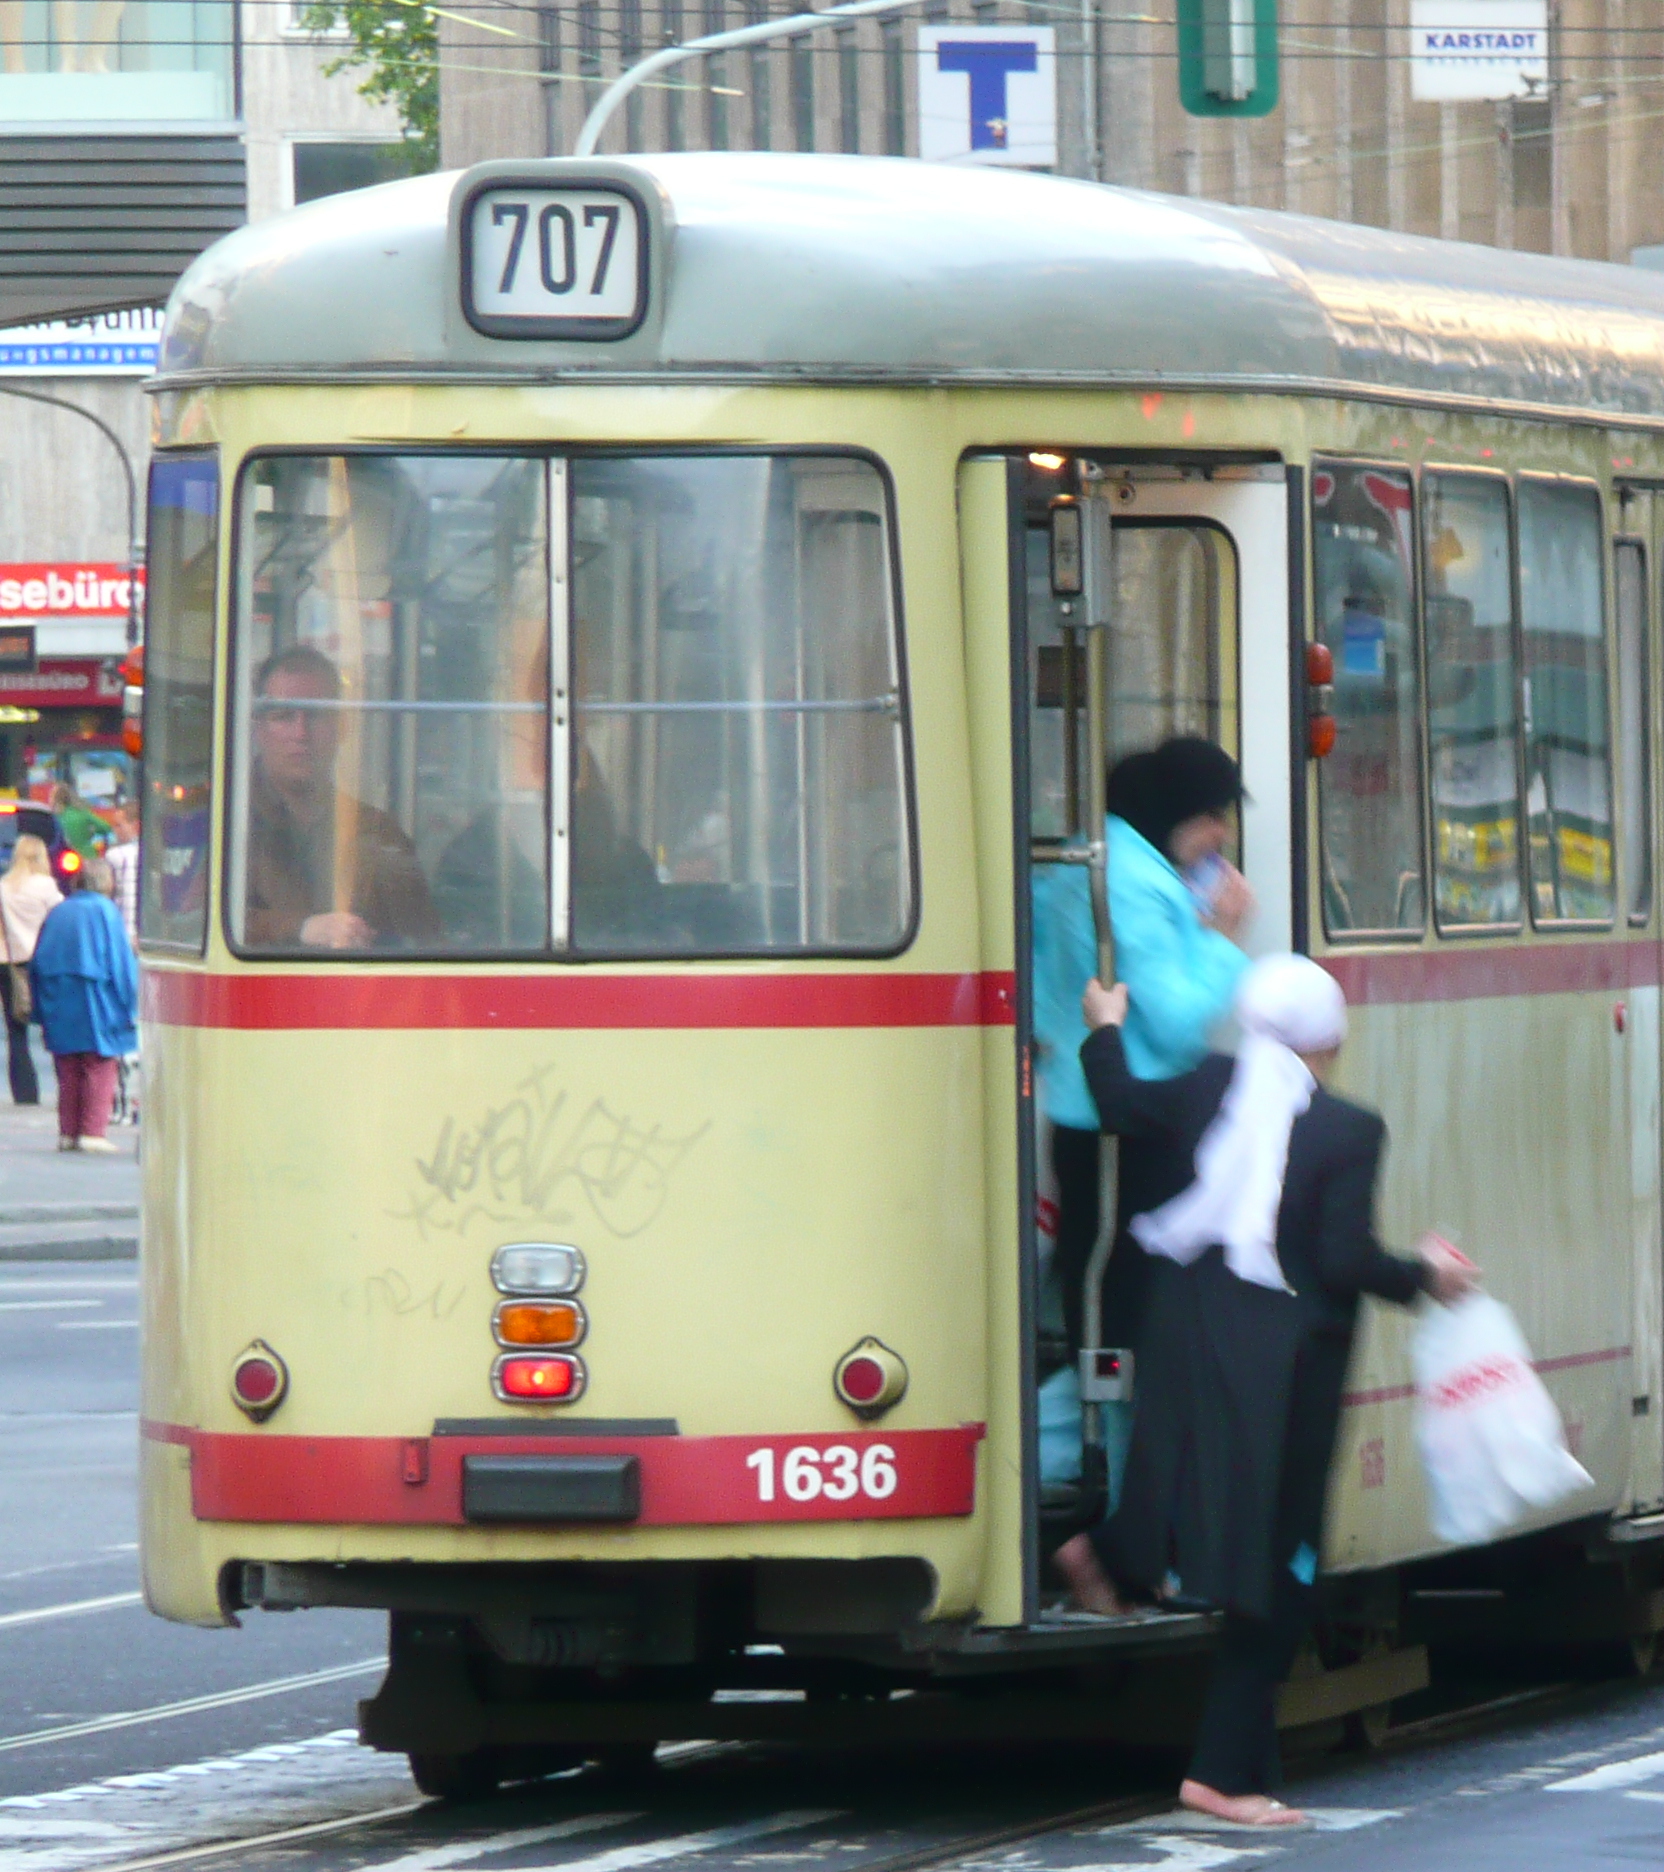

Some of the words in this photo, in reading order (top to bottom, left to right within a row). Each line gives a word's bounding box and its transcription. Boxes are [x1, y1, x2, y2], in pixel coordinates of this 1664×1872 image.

[1426, 33, 1536, 49] KARSTADT
[937, 41, 1038, 151] T
[492, 203, 620, 295] 707
[746, 1443, 898, 1502] 1636
